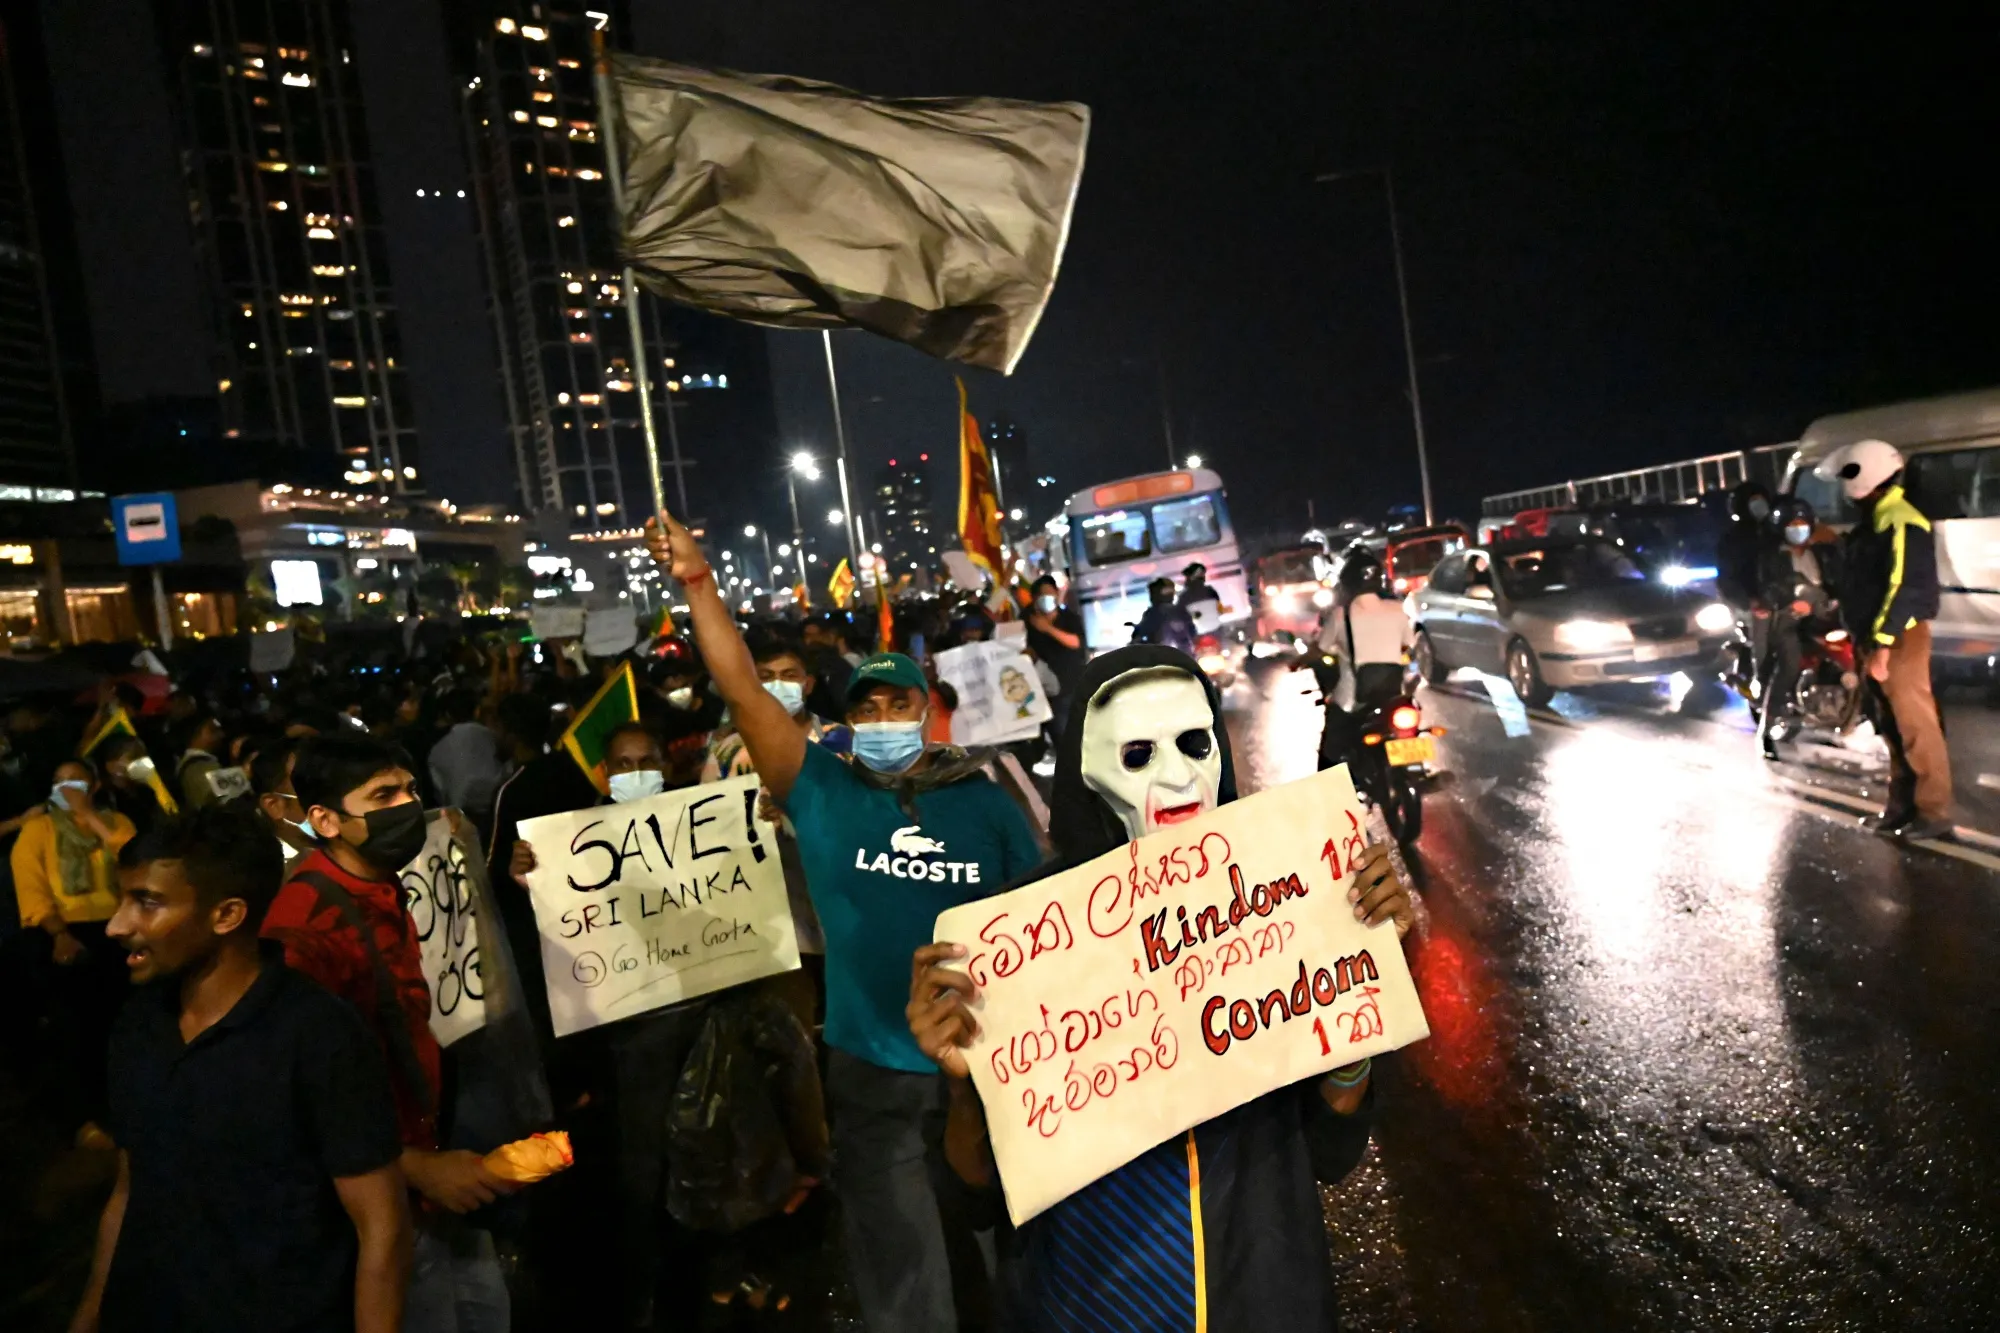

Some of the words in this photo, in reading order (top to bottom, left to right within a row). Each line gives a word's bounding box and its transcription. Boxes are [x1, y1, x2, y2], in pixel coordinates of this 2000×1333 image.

[567, 789, 767, 892] SAVE!
[855, 848, 981, 884] LACOSTE
[560, 898, 622, 939] SRI
[641, 865, 752, 919] LANKA
[612, 944, 638, 974] Go
[645, 938, 690, 967] Home
[702, 917, 757, 948] Gota
[1140, 863, 1310, 973] Kindom
[1201, 948, 1380, 1056] Condom
